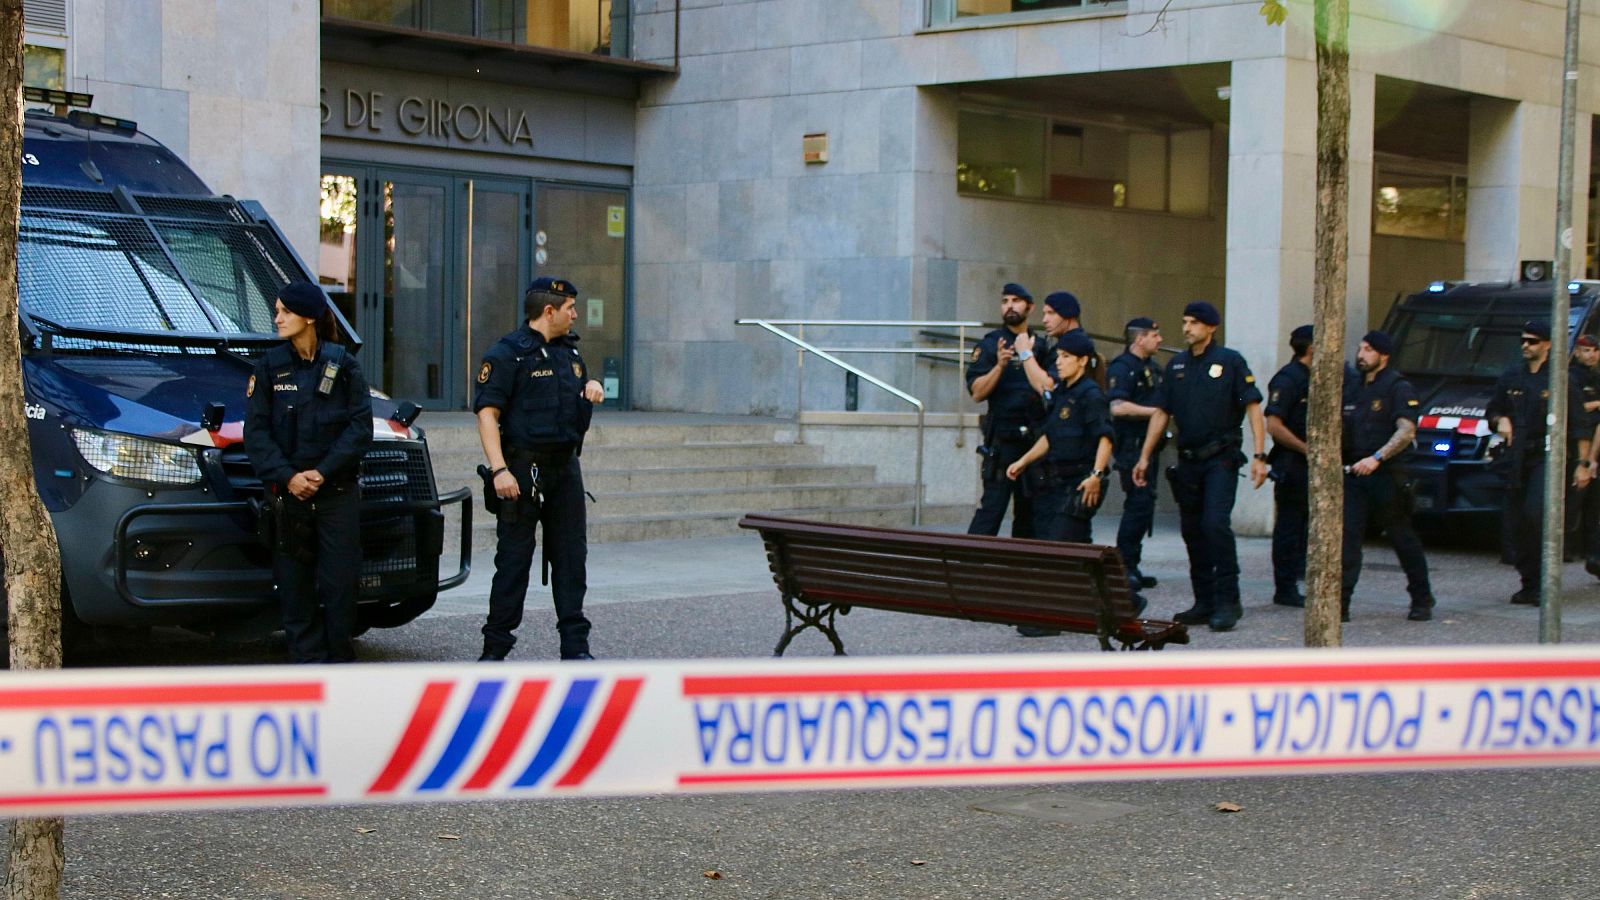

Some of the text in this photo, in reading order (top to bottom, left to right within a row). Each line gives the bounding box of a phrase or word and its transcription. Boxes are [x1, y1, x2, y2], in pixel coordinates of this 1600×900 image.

[345, 89, 384, 131] DE
[399, 96, 533, 147] GIRONA
[274, 384, 298, 392] POLICIA
[531, 369, 554, 378] POLICIA
[1428, 406, 1487, 417] policia
[33, 711, 319, 784] NO PASSEU
[692, 691, 998, 765] D'ESQUADRA
[1014, 693, 1208, 758] MOSSOS
[1250, 689, 1425, 752] POLICIA
